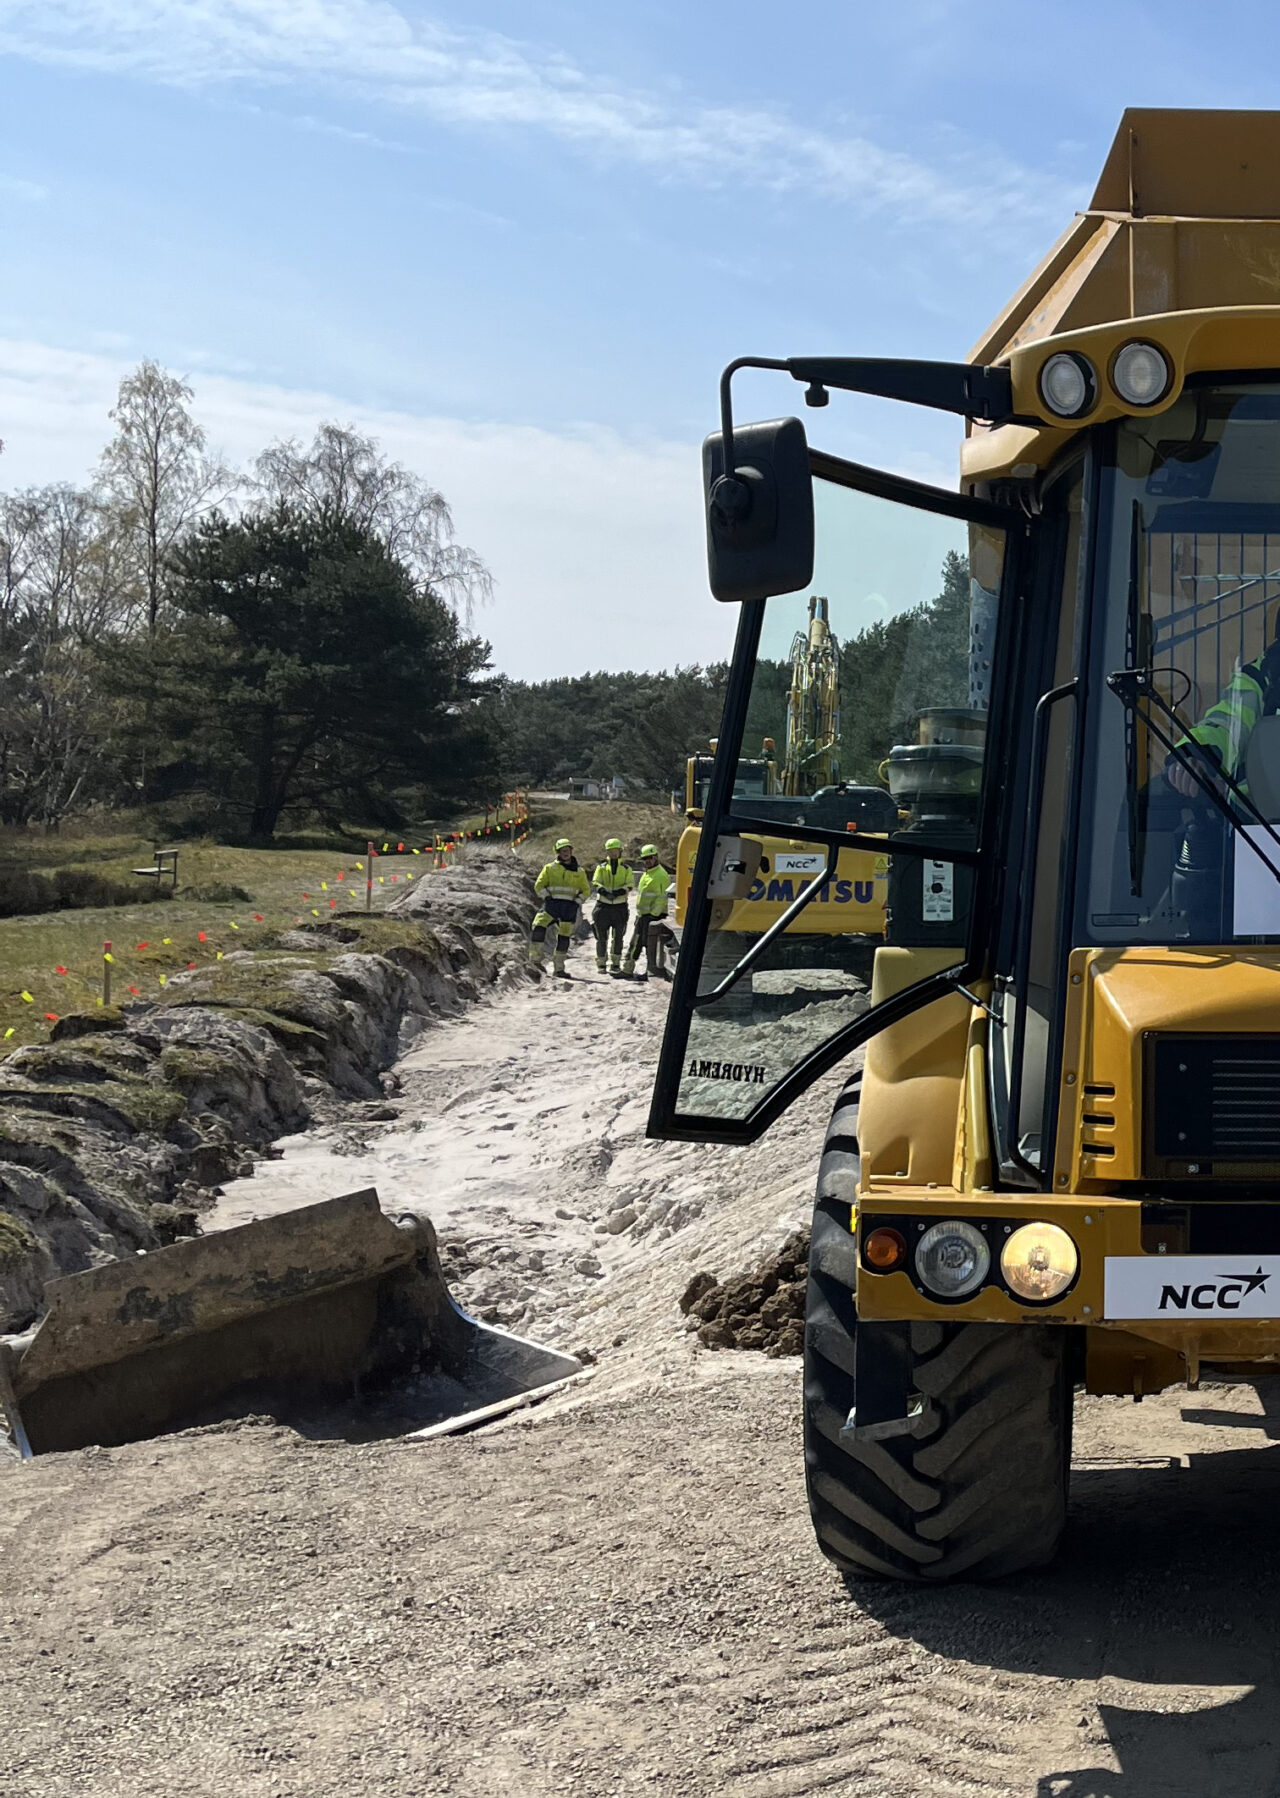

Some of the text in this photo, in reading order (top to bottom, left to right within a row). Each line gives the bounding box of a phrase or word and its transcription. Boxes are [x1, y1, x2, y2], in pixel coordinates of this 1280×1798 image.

[786, 860, 810, 869] NCC
[746, 873, 874, 904] OMTSU
[1158, 1284, 1243, 1310] NCC
